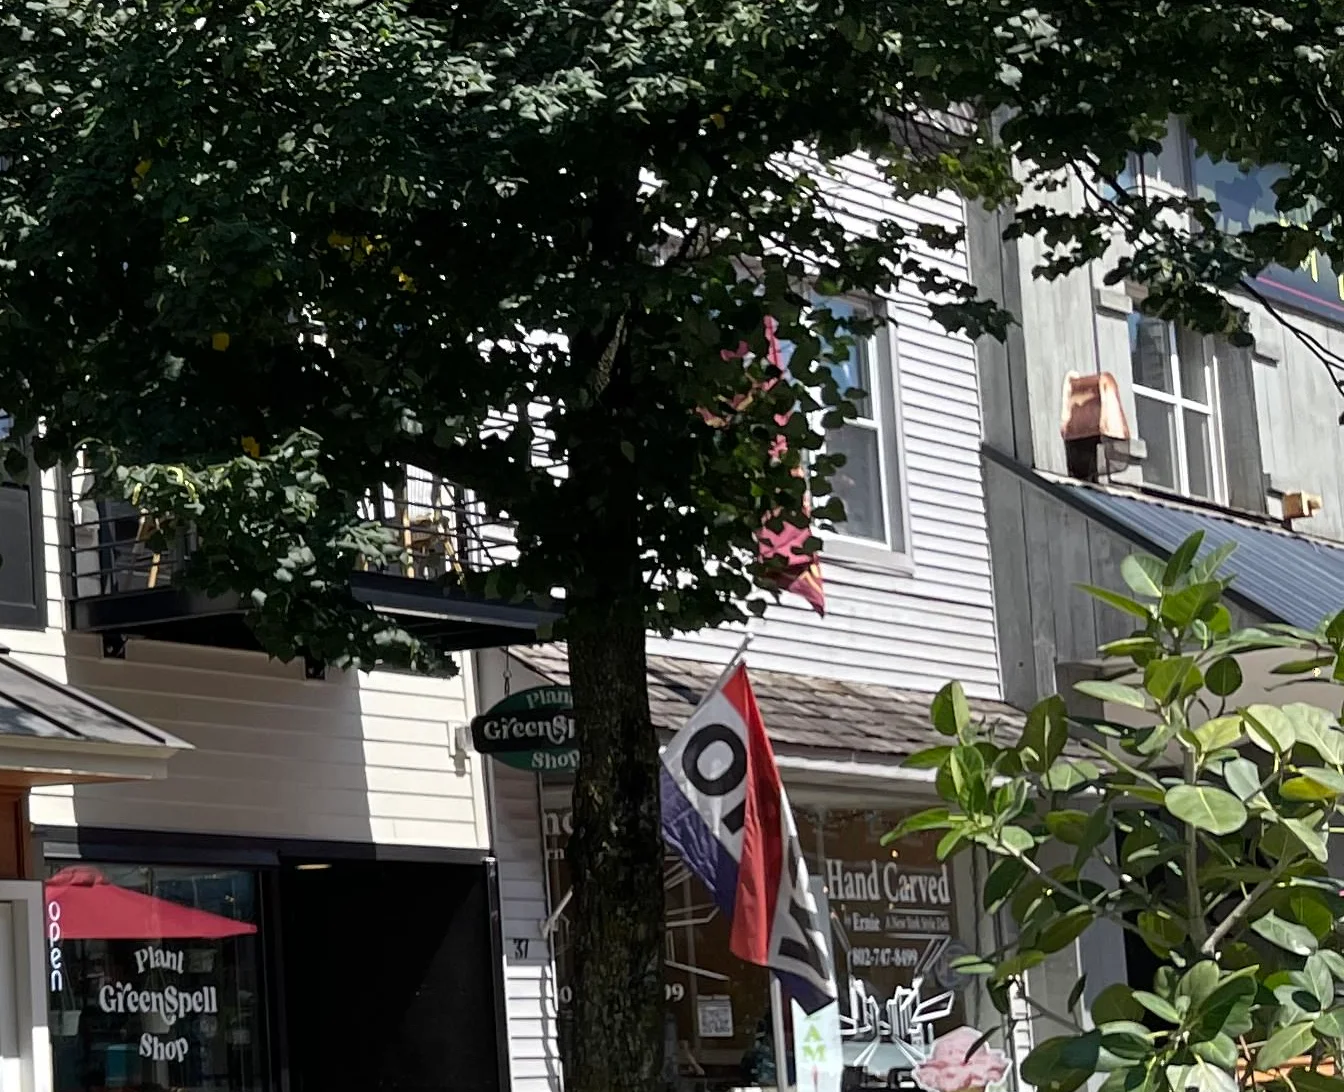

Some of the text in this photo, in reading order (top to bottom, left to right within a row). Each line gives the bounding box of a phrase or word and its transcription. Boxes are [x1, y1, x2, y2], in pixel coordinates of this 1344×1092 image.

[826, 859, 952, 904] Hand Carved
[48, 900, 63, 992] open
[134, 946, 185, 974] Plant
[513, 938, 529, 959] 37
[99, 981, 218, 1026] GreenSpell
[139, 1032, 189, 1063] Shop
